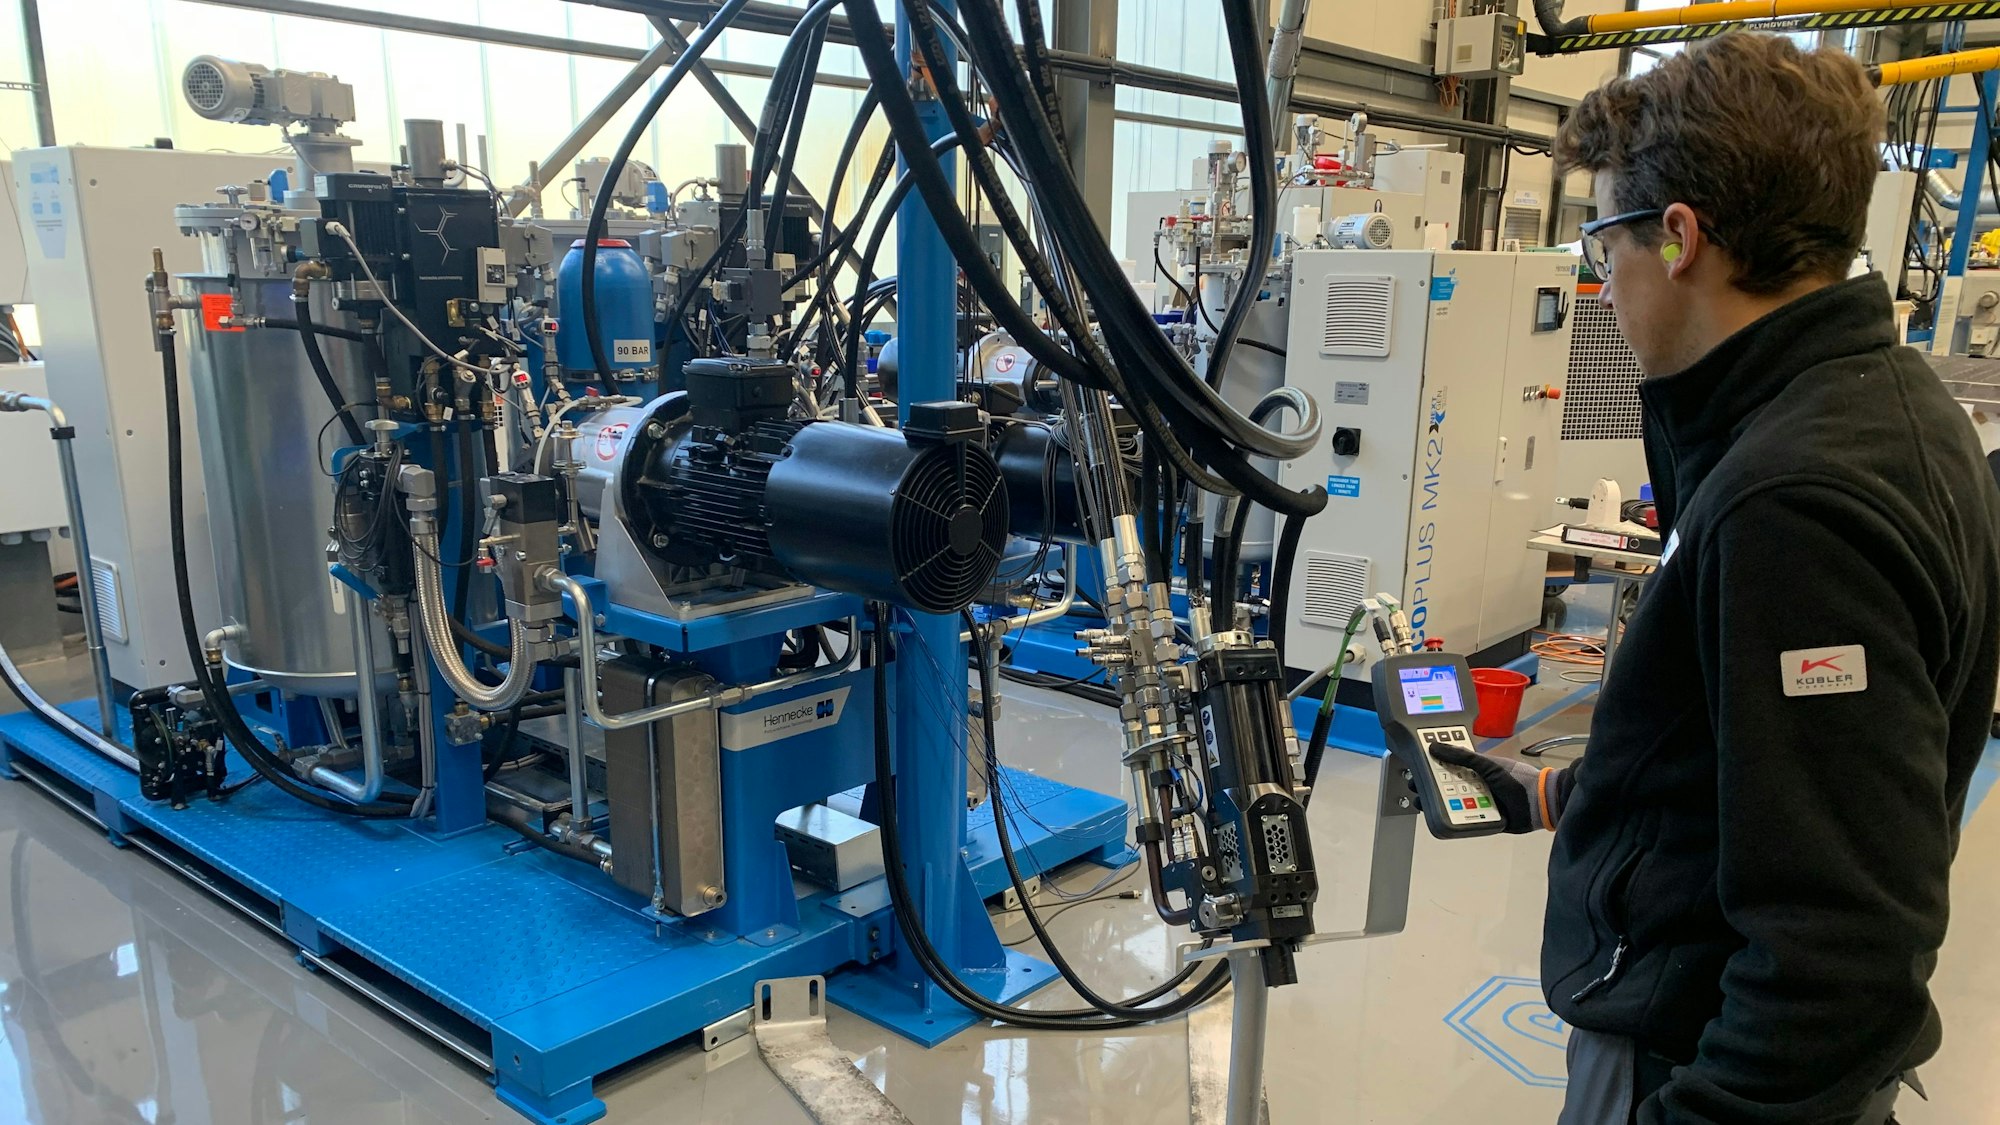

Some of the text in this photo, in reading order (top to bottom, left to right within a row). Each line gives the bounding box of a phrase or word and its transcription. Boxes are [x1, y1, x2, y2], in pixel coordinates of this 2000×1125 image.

[617, 346, 649, 355] 90 BAR
[1422, 437, 1444, 511] MK2
[1411, 521, 1436, 652] COPLUS
[763, 706, 813, 727] Hennecke
